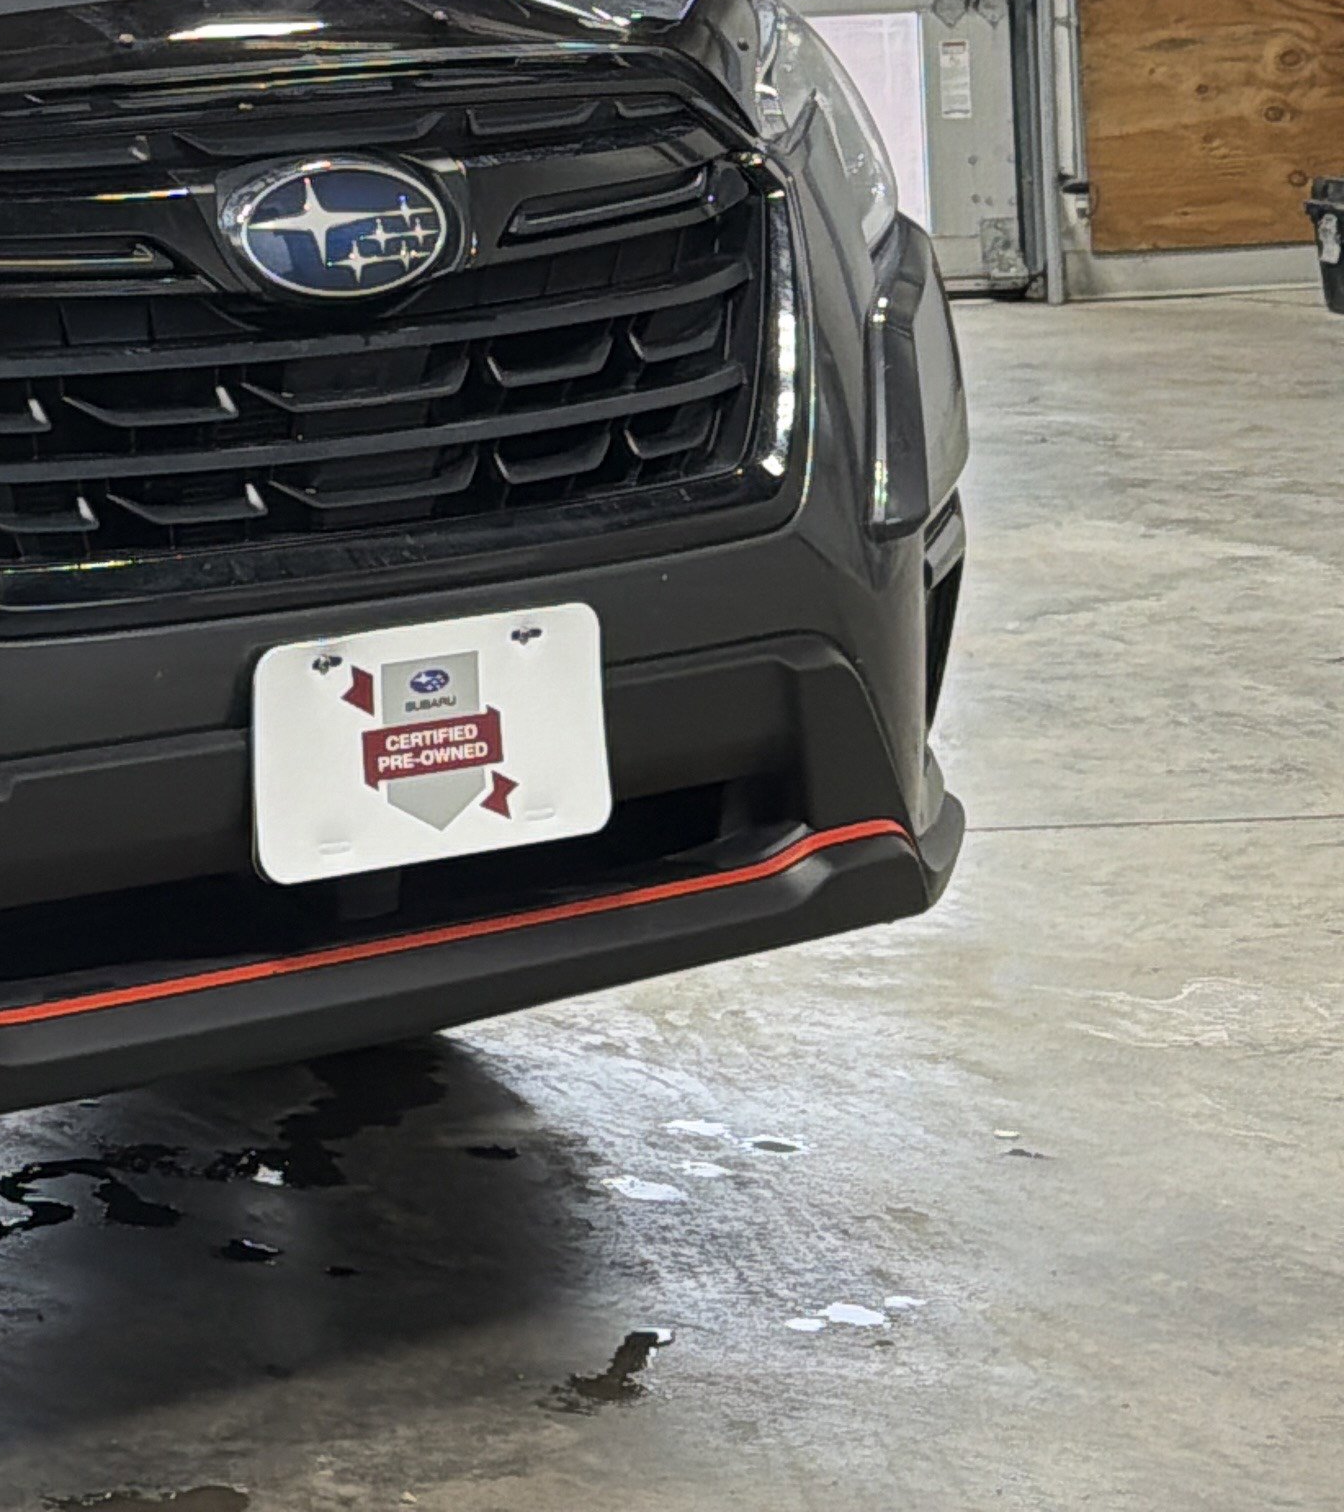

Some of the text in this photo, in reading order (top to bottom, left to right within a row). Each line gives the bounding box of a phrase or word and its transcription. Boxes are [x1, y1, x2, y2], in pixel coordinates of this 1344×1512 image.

[405, 696, 457, 712] SUBARU
[385, 723, 478, 751] CERTIFIED
[377, 741, 489, 773] PRE-OWNED
